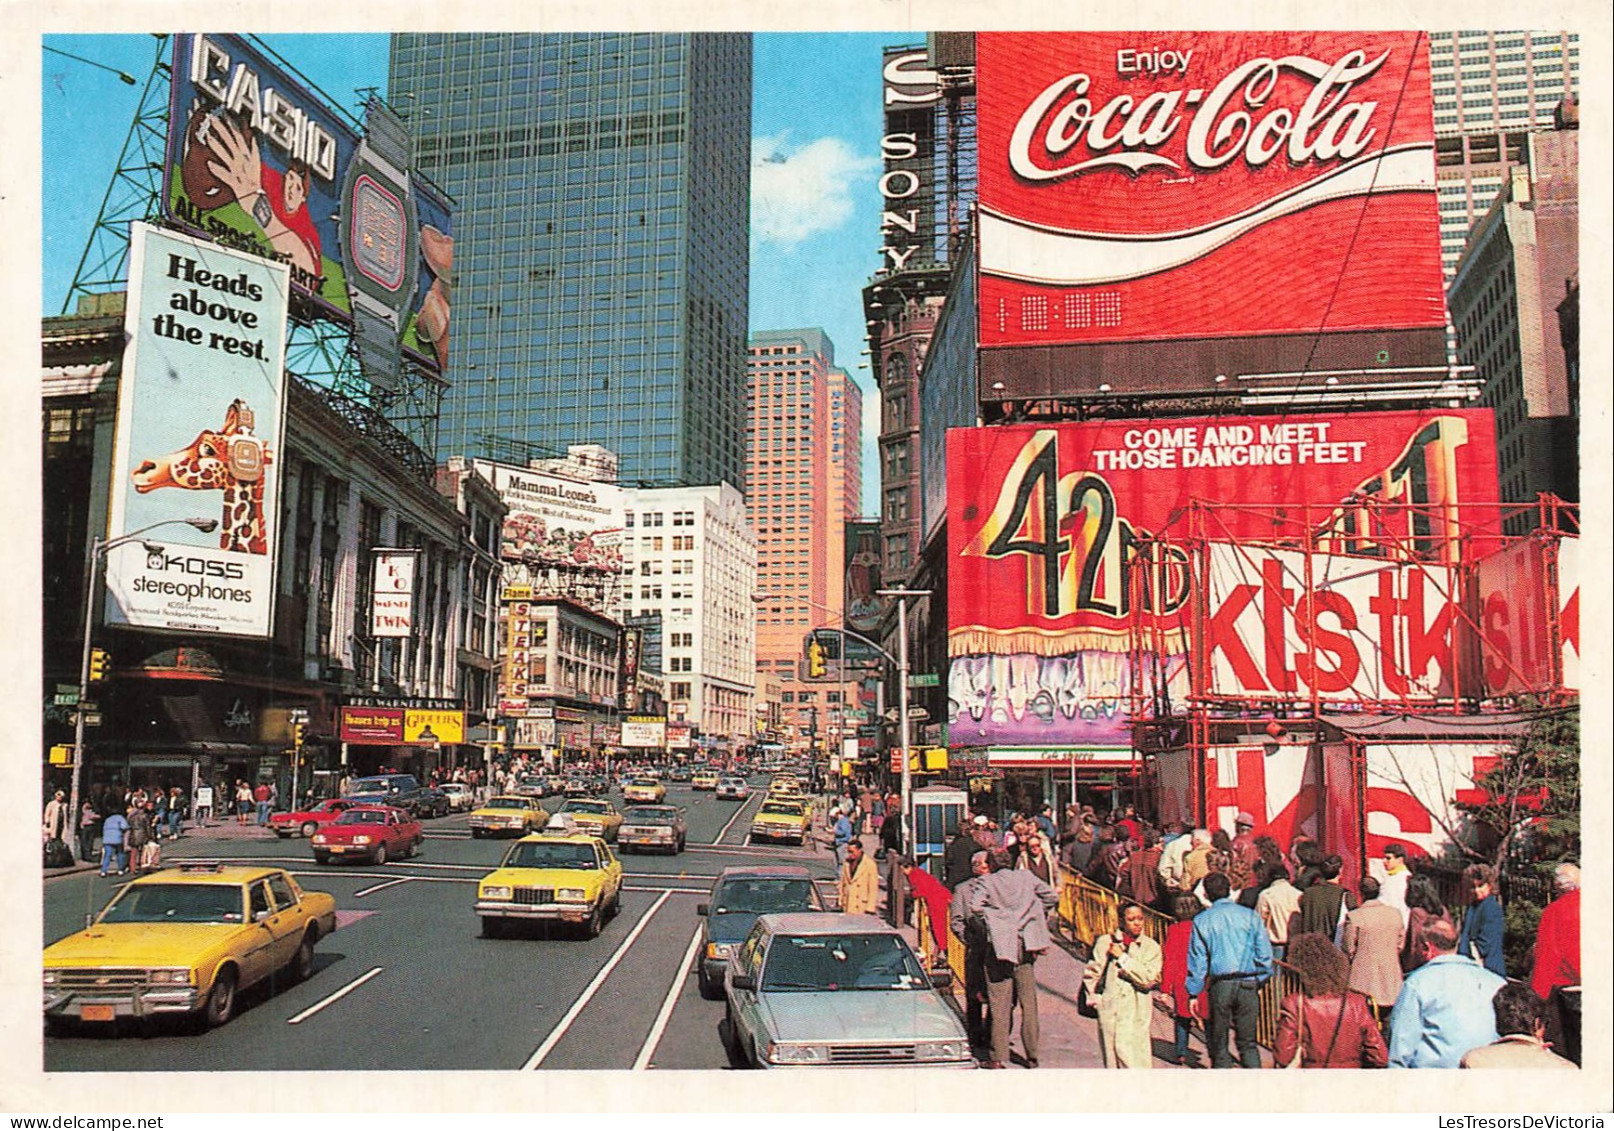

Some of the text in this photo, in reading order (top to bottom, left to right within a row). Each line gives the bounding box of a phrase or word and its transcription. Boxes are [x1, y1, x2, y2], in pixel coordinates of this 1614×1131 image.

[1117, 46, 1193, 74] Enjoy
[190, 33, 337, 182] CASIO
[1009, 48, 1390, 181] Coca-Cola
[877, 132, 920, 270] SONY
[166, 253, 263, 302] Heads
[169, 288, 258, 329] above
[153, 313, 270, 363] the rest.
[1124, 422, 1331, 448] COME AND MEET
[1093, 442, 1367, 470] THOSE DANCING FEET
[508, 475, 597, 504] Mamma Leone's
[165, 554, 243, 580] KOSS
[133, 575, 252, 603] stereophones
[502, 587, 531, 599] Flame
[375, 614, 410, 629] TWIN
[514, 603, 529, 695] STEAKS
[427, 699, 457, 709] TWIN
